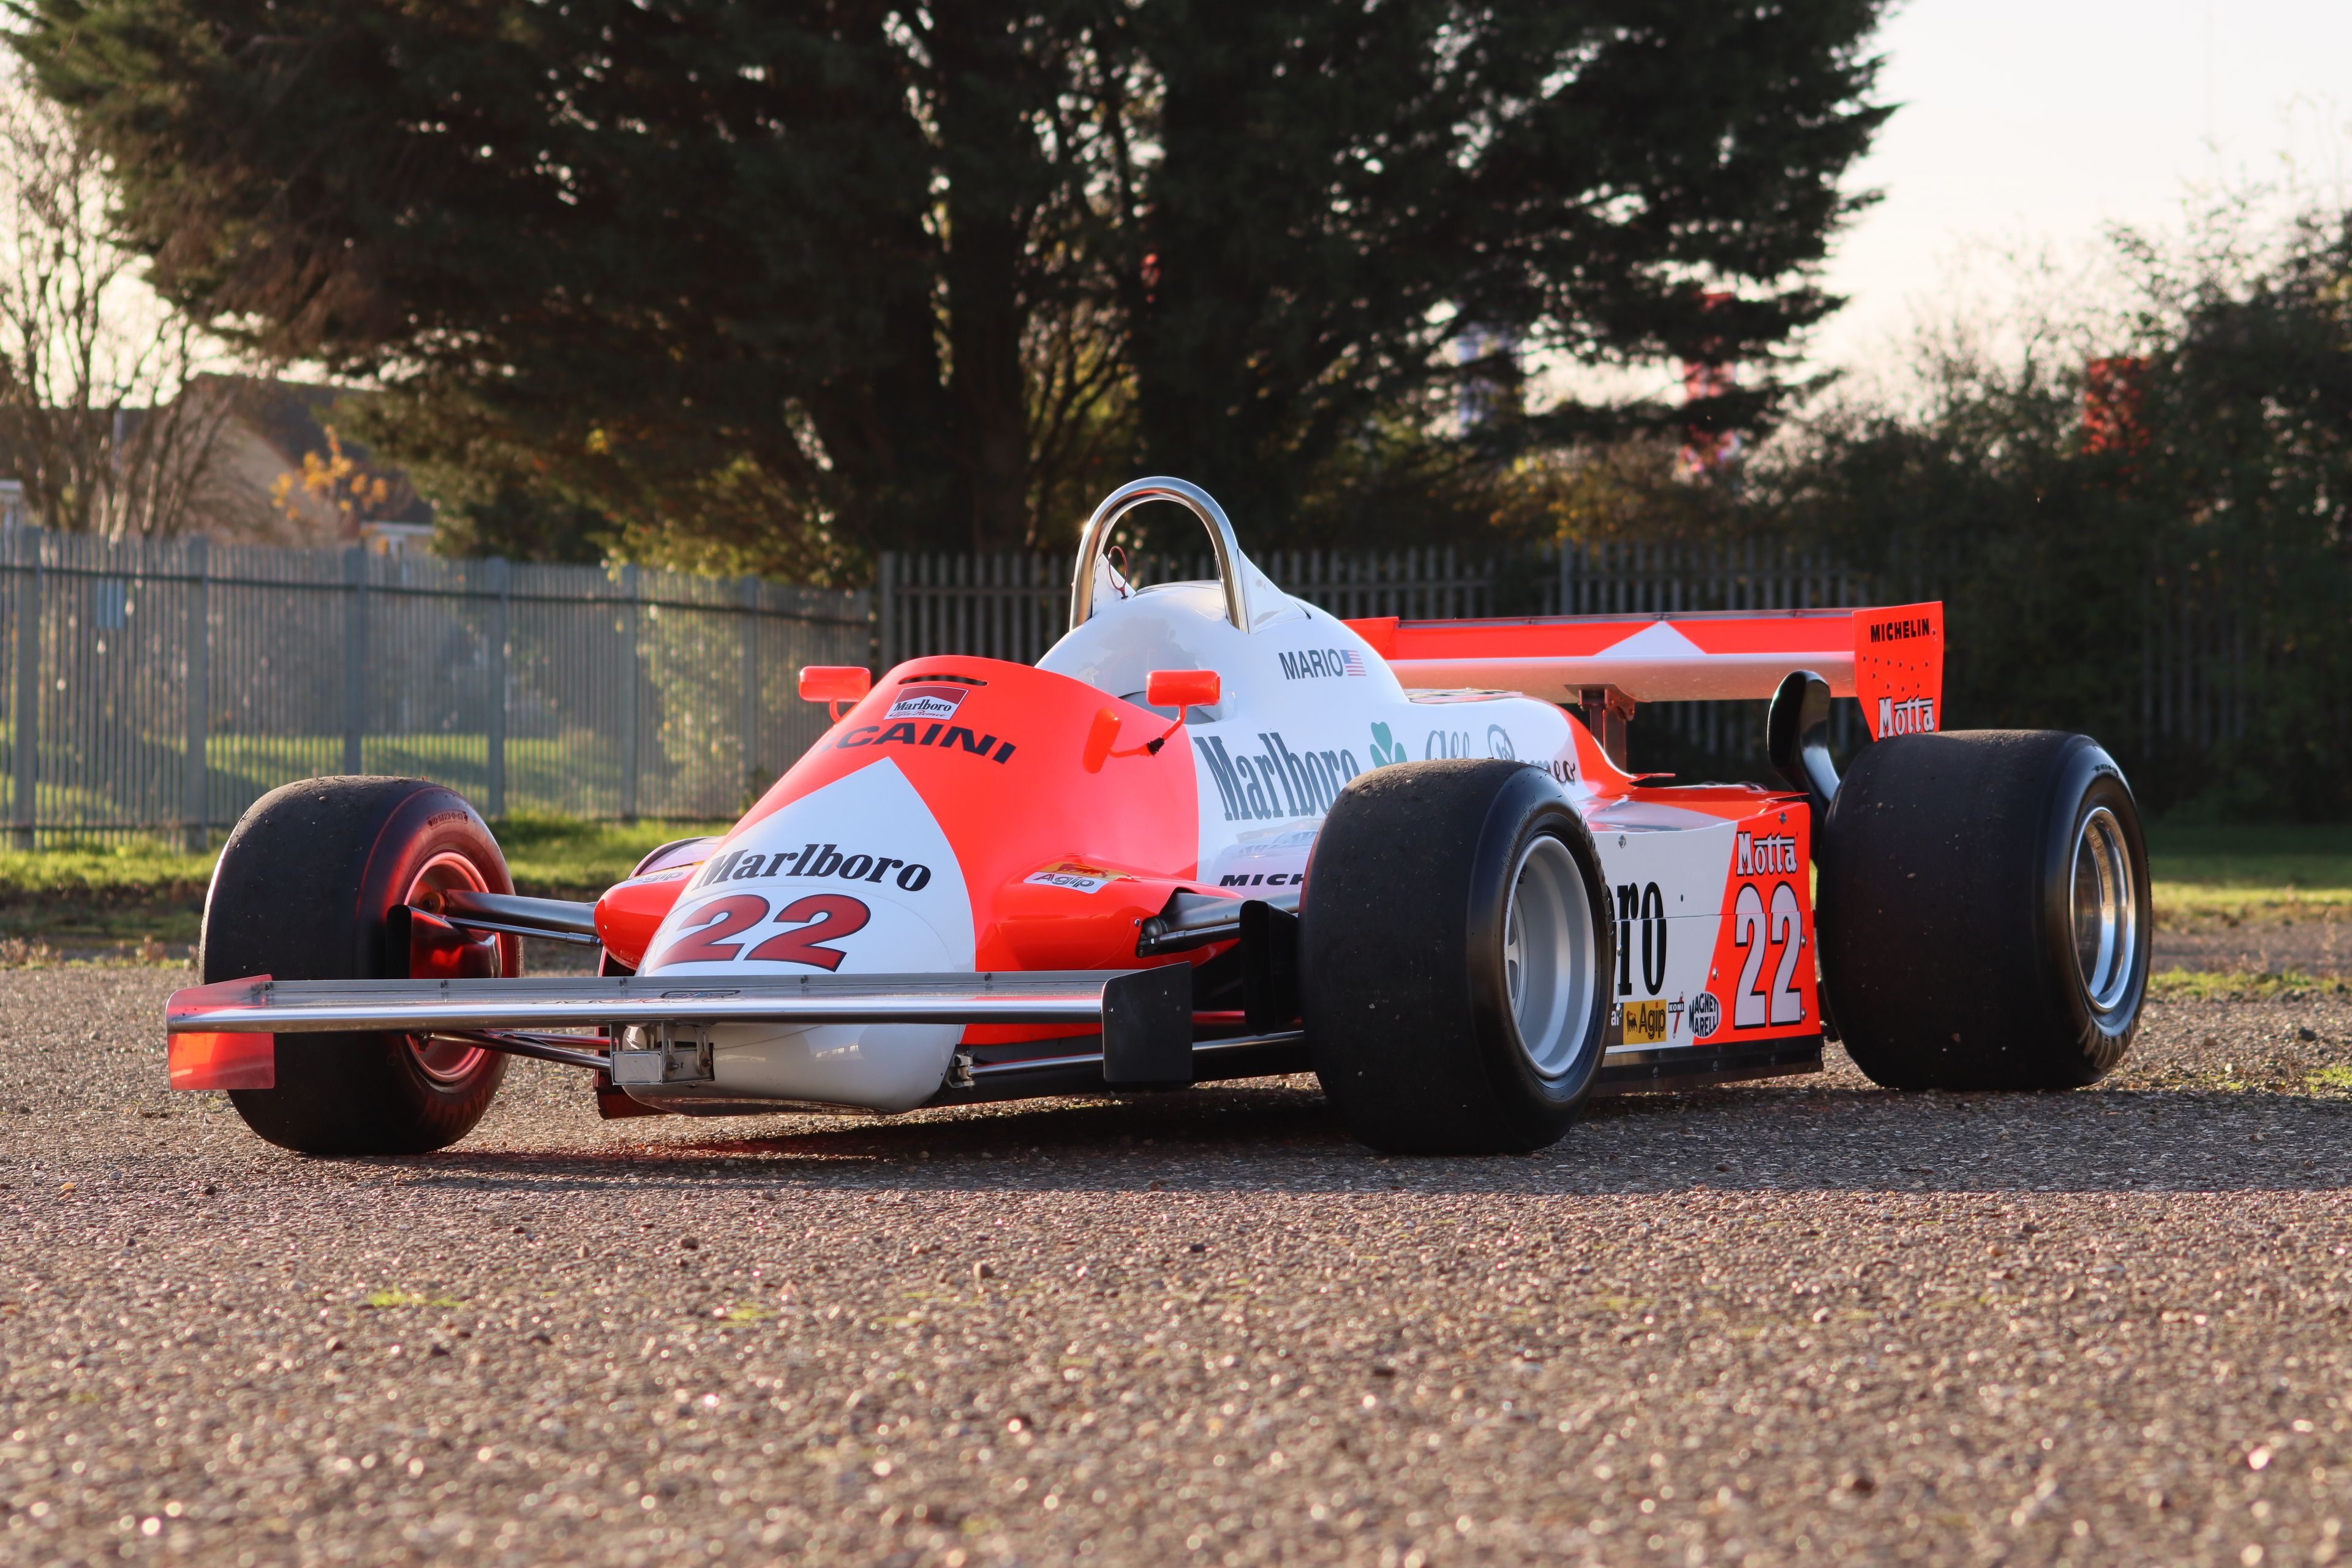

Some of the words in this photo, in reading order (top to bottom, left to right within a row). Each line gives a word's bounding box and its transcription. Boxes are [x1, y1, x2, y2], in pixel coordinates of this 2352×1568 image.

[1870, 618, 1930, 643] MICHELIN
[1278, 649, 1344, 680] MARIO
[894, 699, 952, 712] Marlboro
[1878, 694, 1936, 739] Motta
[691, 844, 932, 892] Marlboro
[1736, 831, 1797, 876] Motta
[1033, 873, 1095, 888] Agip
[648, 893, 872, 973] 22
[1733, 880, 1803, 1031] 22
[1638, 1001, 1666, 1039] Agip
[1668, 1002, 1684, 1011] KONI
